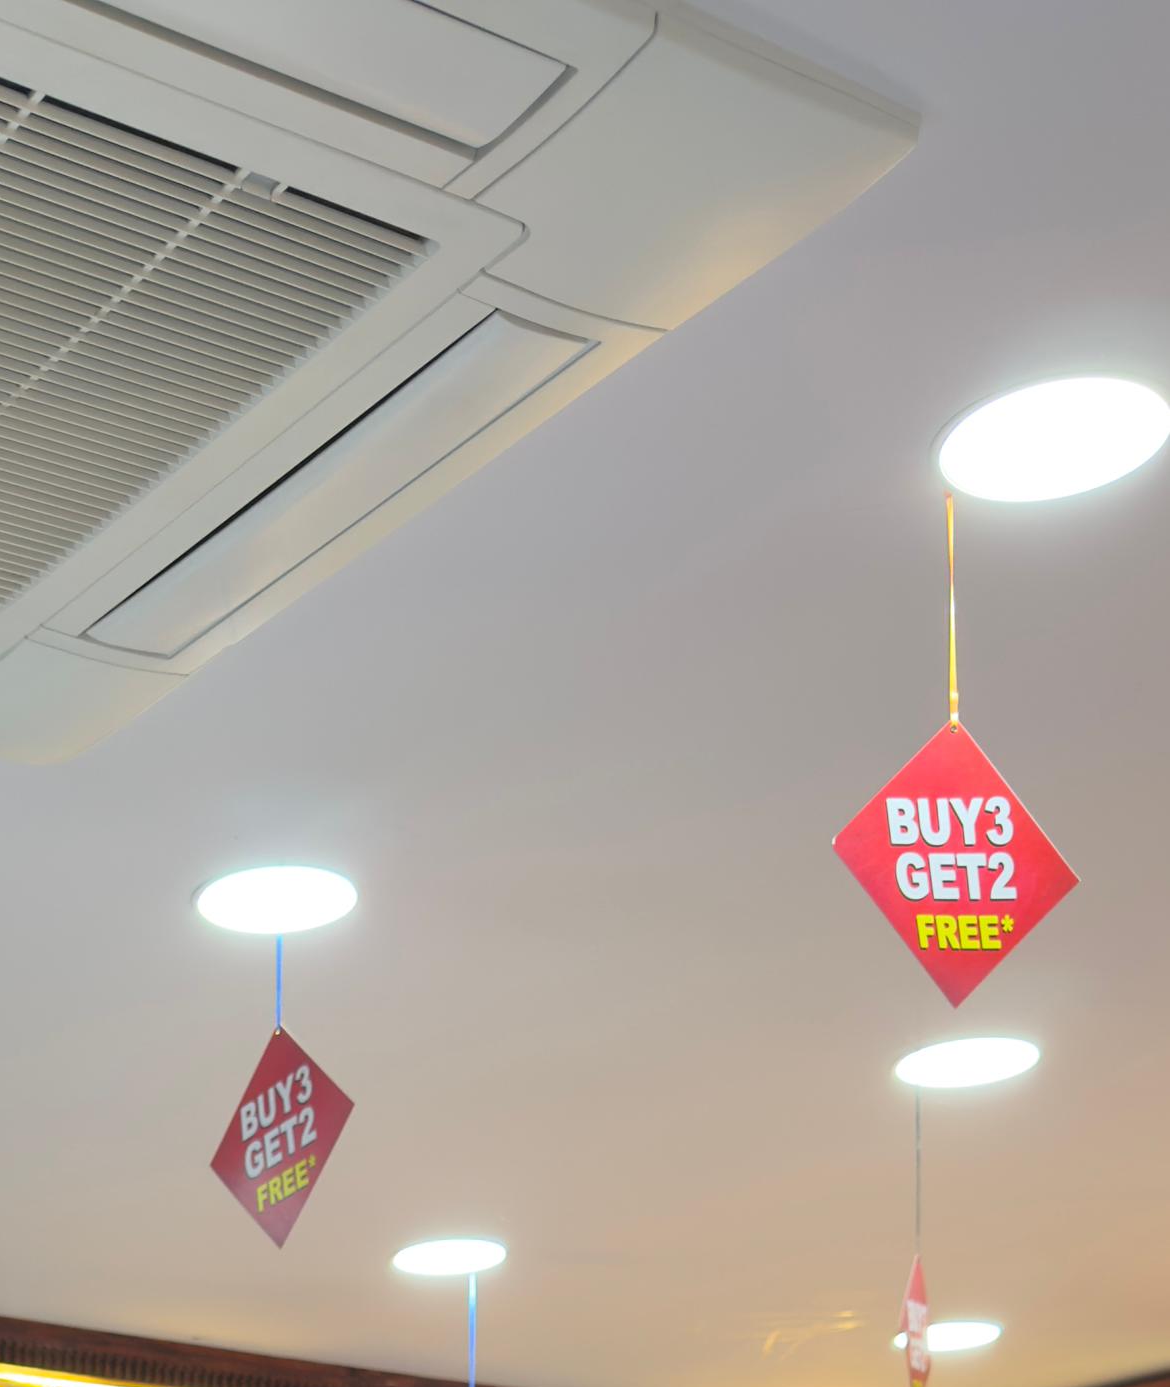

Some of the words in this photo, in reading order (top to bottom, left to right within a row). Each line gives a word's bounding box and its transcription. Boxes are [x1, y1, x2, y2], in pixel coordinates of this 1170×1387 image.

[886, 796, 1014, 846] BUY3
[895, 852, 1018, 901] GET2
[240, 1065, 313, 1142] BUY3
[244, 1106, 317, 1179] GET2
